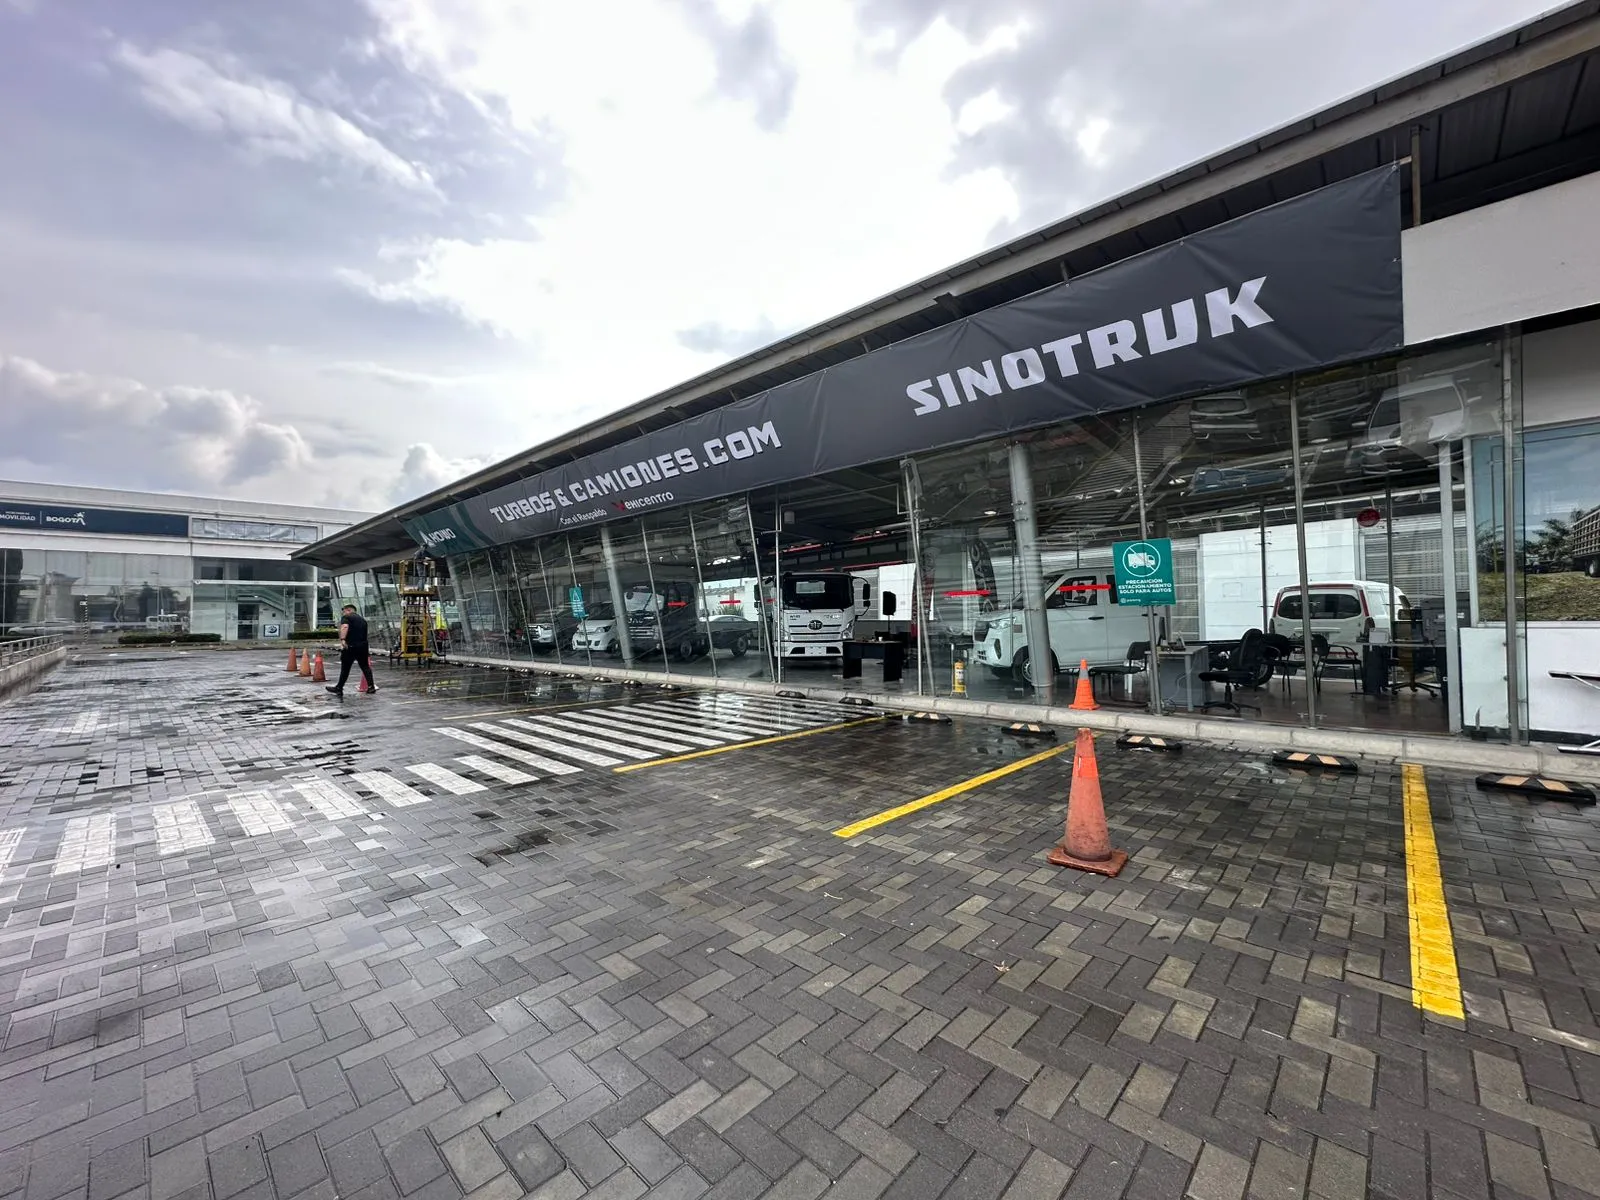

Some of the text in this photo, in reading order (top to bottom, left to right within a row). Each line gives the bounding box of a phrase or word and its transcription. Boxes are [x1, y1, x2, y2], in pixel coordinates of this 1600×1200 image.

[906, 276, 1274, 416] SINOTRUK
[489, 489, 557, 524] TURBOS
[553, 487, 574, 508] &
[568, 447, 699, 503] CAMIONES
[428, 527, 456, 543] HOWO
[577, 508, 607, 521] Respaldo
